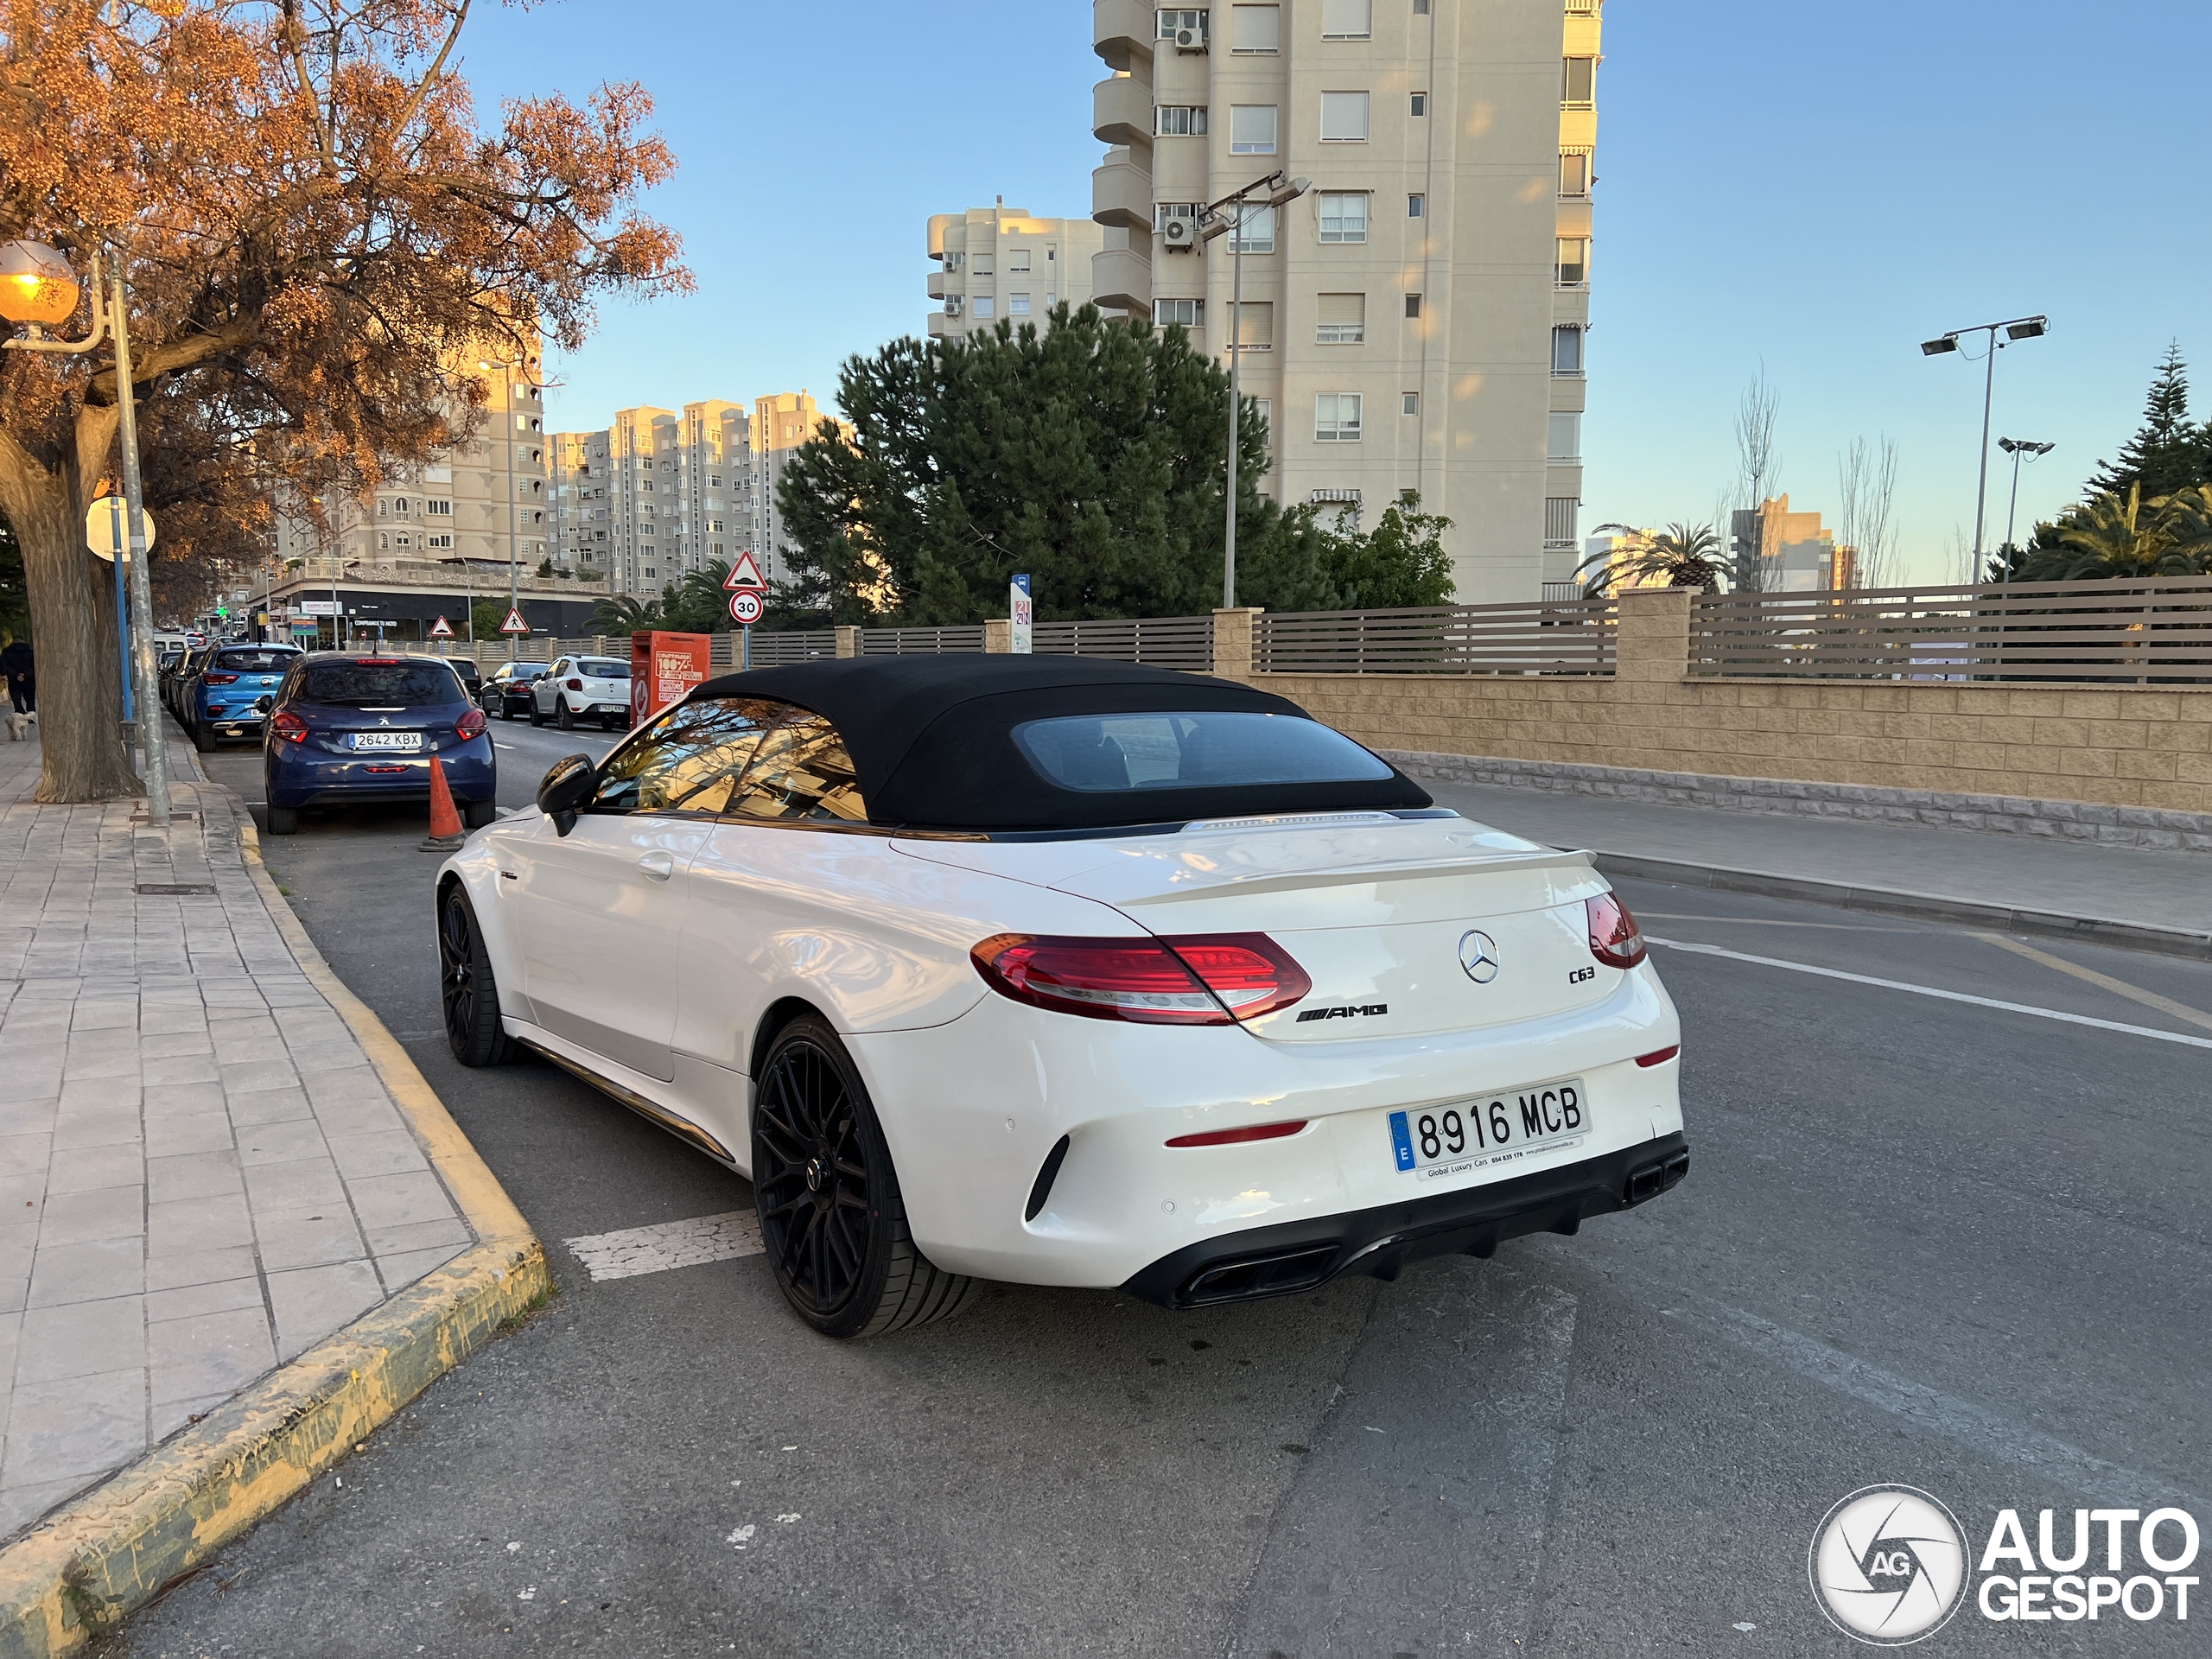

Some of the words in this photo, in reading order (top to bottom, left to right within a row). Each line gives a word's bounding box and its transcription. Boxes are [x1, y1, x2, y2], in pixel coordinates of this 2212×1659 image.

[738, 602, 755, 613] 30
[1018, 602, 1027, 613] 21
[658, 658, 688, 671] 100%
[359, 735, 390, 746] 2642
[395, 734, 419, 744] KBX
[1569, 966, 1595, 984] C63
[1325, 1003, 1388, 1020] AMG
[1418, 1101, 1510, 1160] 8916
[1519, 1087, 1581, 1139] MCB
[1400, 1147, 1409, 1161] E
[1428, 1166, 1449, 1177] Global
[1451, 1163, 1472, 1173] Luxury
